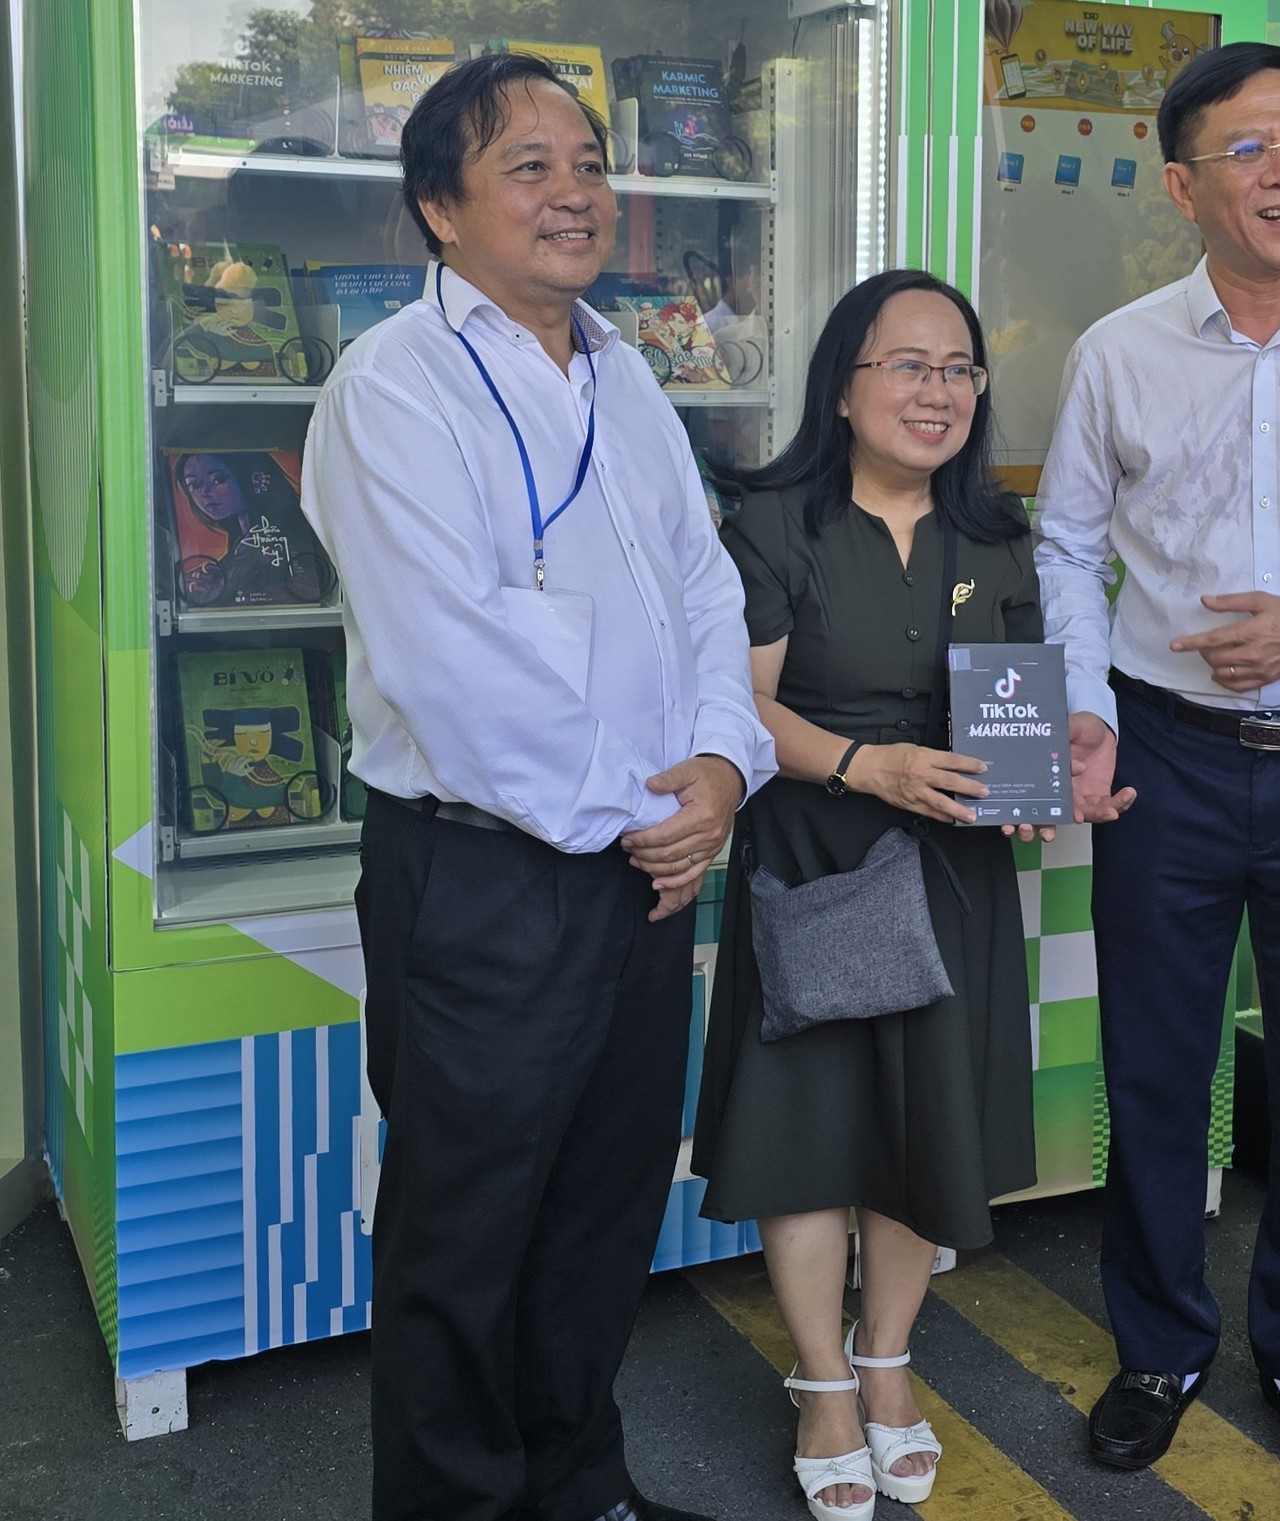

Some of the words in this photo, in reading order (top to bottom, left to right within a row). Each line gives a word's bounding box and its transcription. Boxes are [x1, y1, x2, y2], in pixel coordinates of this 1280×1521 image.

[1065, 20, 1097, 34] NEW
[1102, 22, 1134, 37] WAY
[1077, 34, 1097, 49] OF
[1102, 36, 1134, 51] LIFE
[210, 73, 284, 87] MARKETING
[661, 71, 706, 84] KARMIC
[653, 84, 719, 98] MARKETING
[980, 703, 1039, 719] TikTok
[969, 722, 1052, 737] MARKETING
